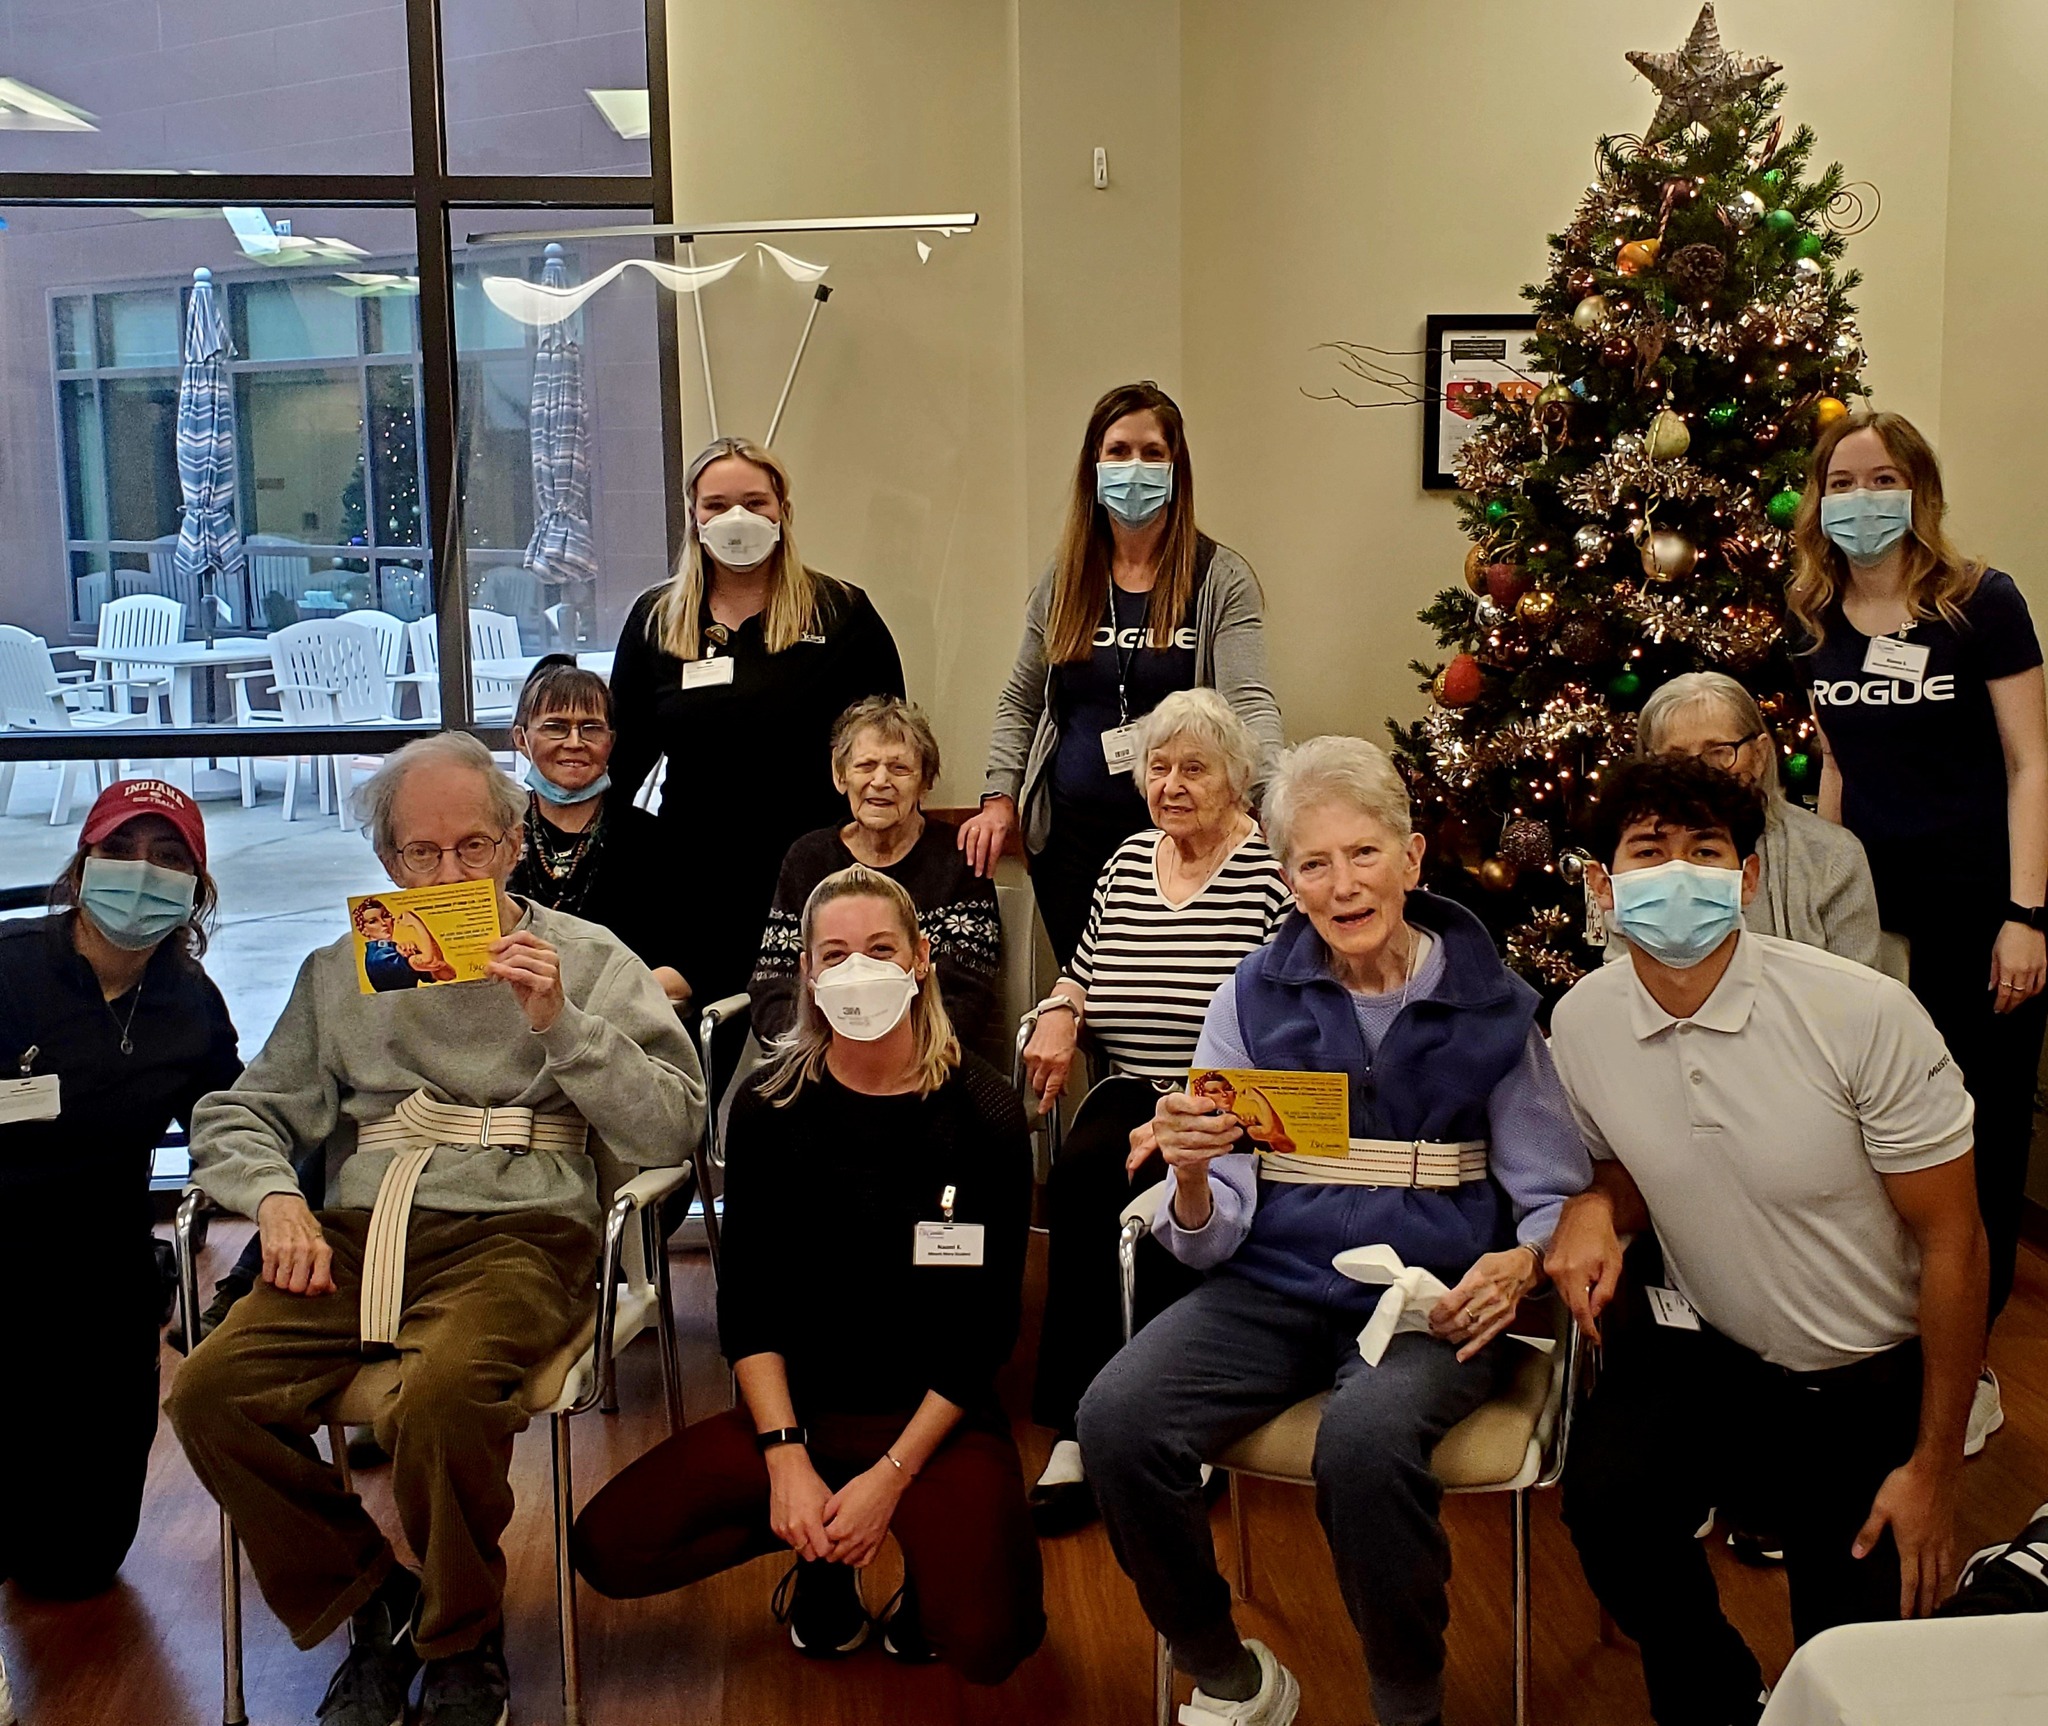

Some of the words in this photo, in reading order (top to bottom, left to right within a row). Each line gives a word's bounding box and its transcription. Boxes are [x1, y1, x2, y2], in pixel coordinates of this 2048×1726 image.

[1092, 626, 1196, 649] OGUE
[1813, 674, 1955, 706] ROGUE
[124, 781, 185, 809] INDIANA
[842, 1006, 861, 1016] 3M
